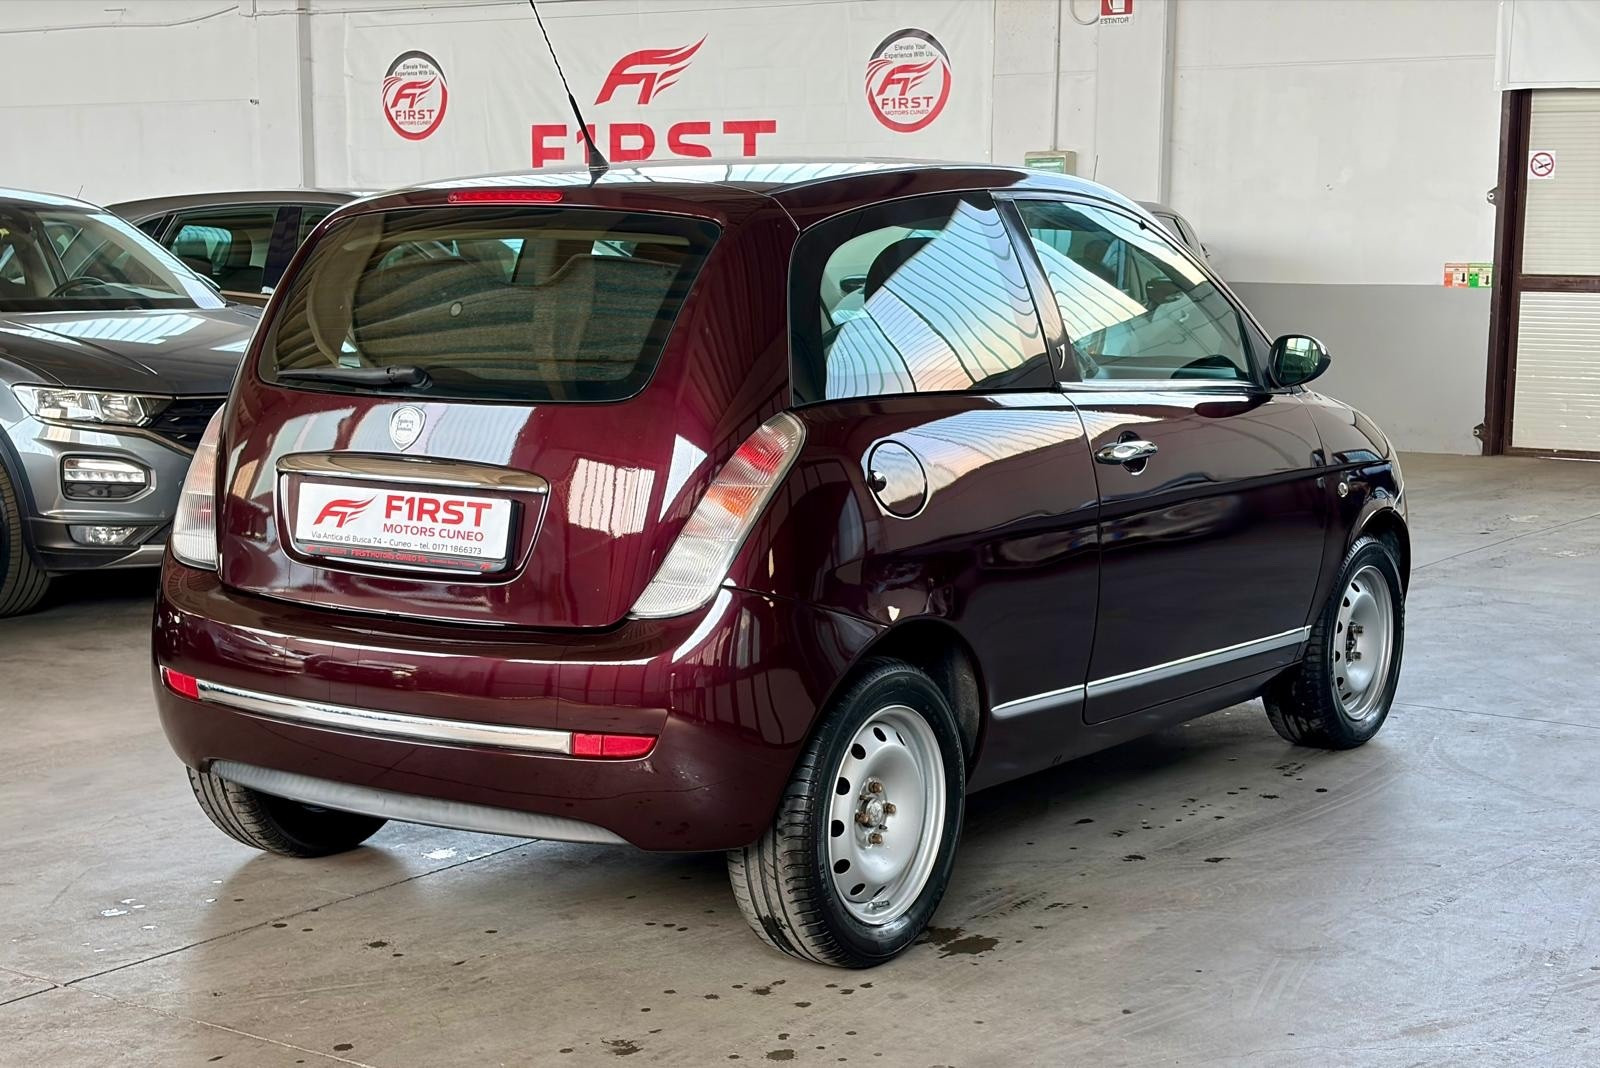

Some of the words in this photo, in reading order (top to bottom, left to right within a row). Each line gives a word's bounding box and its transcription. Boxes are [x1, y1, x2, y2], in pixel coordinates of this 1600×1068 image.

[881, 96, 934, 110] F1RST
[395, 109, 435, 121] F1RST
[385, 494, 492, 527] F1RST
[323, 532, 343, 541] Antica
[344, 533, 350, 541] di
[353, 535, 371, 544] Busca
[389, 539, 411, 548] Cuneo
[419, 542, 430, 550] tel.
[383, 523, 435, 537] MOTORS
[438, 528, 484, 542] CUNEO
